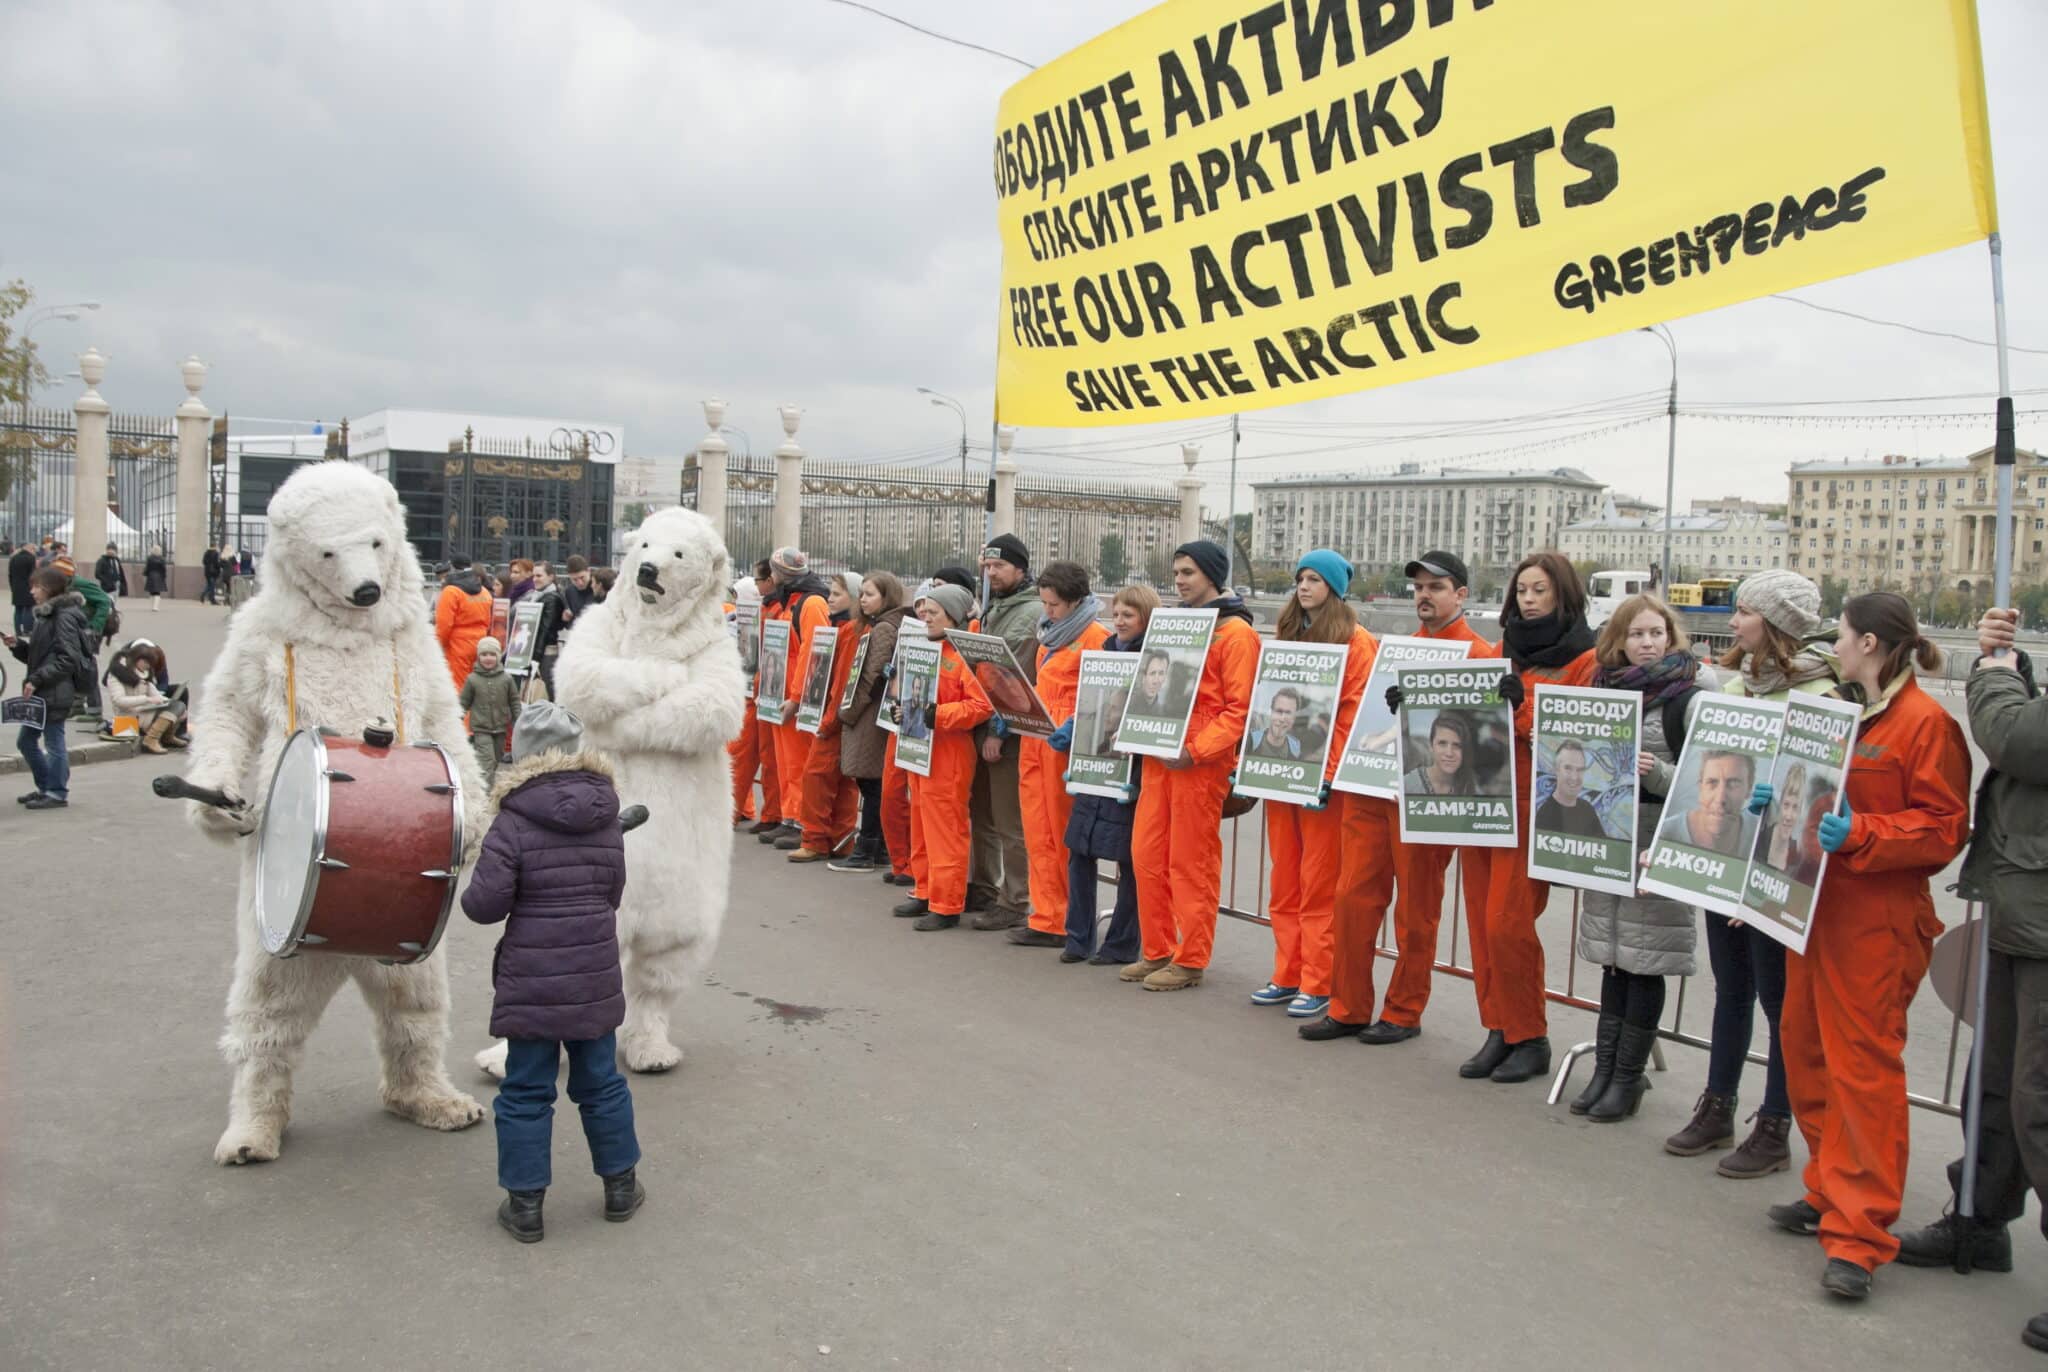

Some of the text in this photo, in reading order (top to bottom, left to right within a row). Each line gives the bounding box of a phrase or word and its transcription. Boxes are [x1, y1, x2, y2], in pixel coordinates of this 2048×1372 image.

[994, 71, 1151, 201] ОБОДИТЕ
[1022, 56, 1449, 262] СПАСИТЕ АРКТИКУ
[1009, 105, 1619, 347] FREE OUR ACTIVISTS
[1554, 166, 1886, 313] GREENPEACE
[1066, 282, 1480, 412] SAVE THE ARCTIC
[1152, 618, 1210, 634] СВОБОДУ
[1083, 660, 1136, 676] СВОБОДУ
[1265, 652, 1339, 671] СВОБОДУ
[1262, 669, 1336, 684] #ARCTIC30
[1403, 672, 1503, 690] СВОБОДУ
[1541, 698, 1633, 721] СВОБОДУ
[1126, 719, 1177, 735] ТОМАШ
[1541, 719, 1632, 739] #ARCTIC30
[1700, 707, 1783, 738] СВОБОД
[1788, 708, 1851, 742] СВОБОДУ
[1072, 759, 1115, 774] ДЕНИС
[1245, 760, 1304, 780] МАРКО
[1536, 834, 1607, 860] КОЛИН
[1654, 847, 1726, 879] ДЖОН
[1750, 869, 1790, 903] СИНИ
